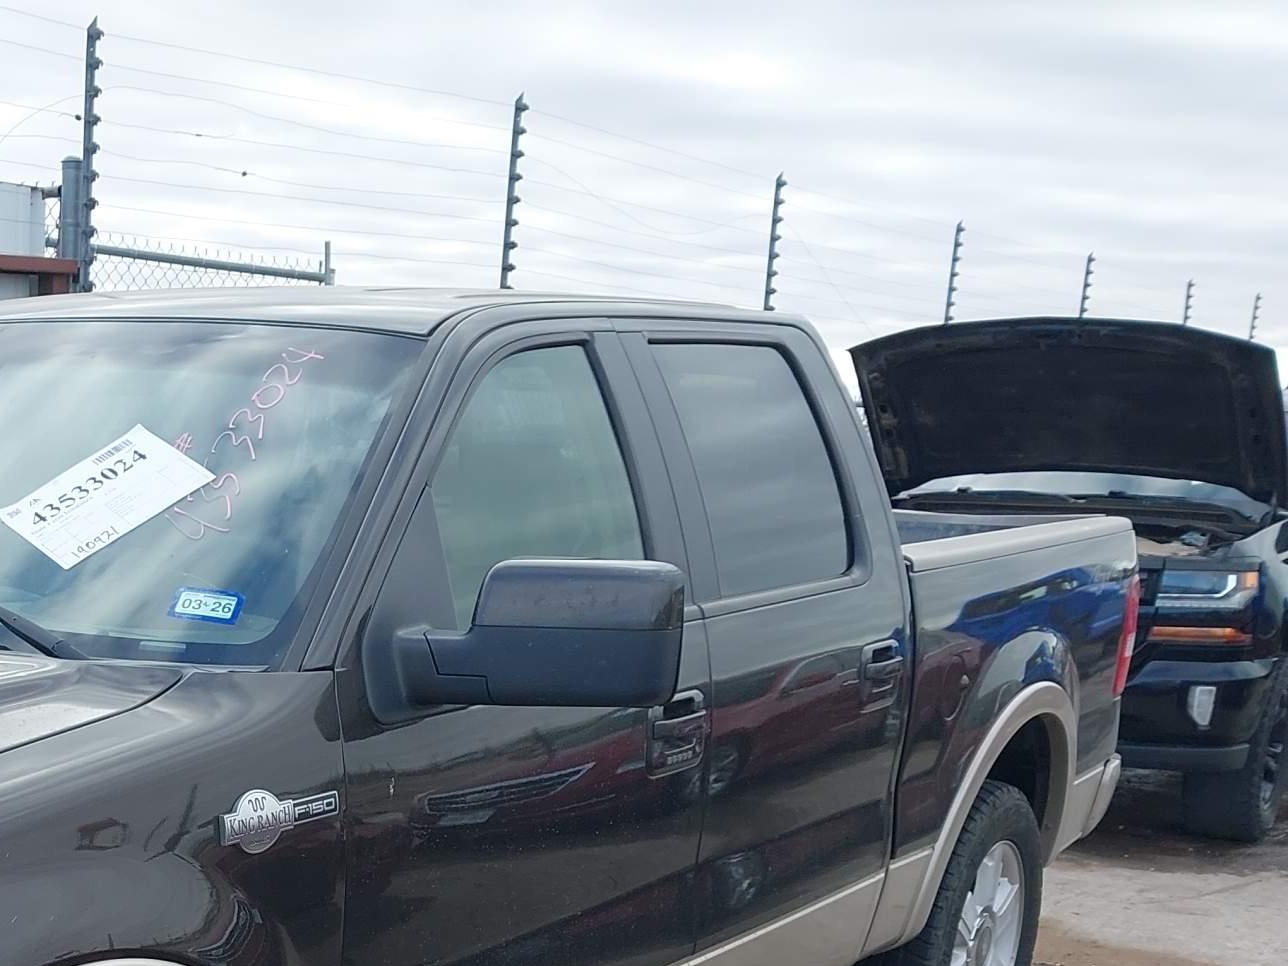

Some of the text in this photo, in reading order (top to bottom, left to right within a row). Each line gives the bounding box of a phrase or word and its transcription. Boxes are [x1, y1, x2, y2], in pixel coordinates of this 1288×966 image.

[32, 449, 148, 526] 43533024
[181, 598, 233, 614] 03 26
[229, 804, 292, 837] KING RANCH
